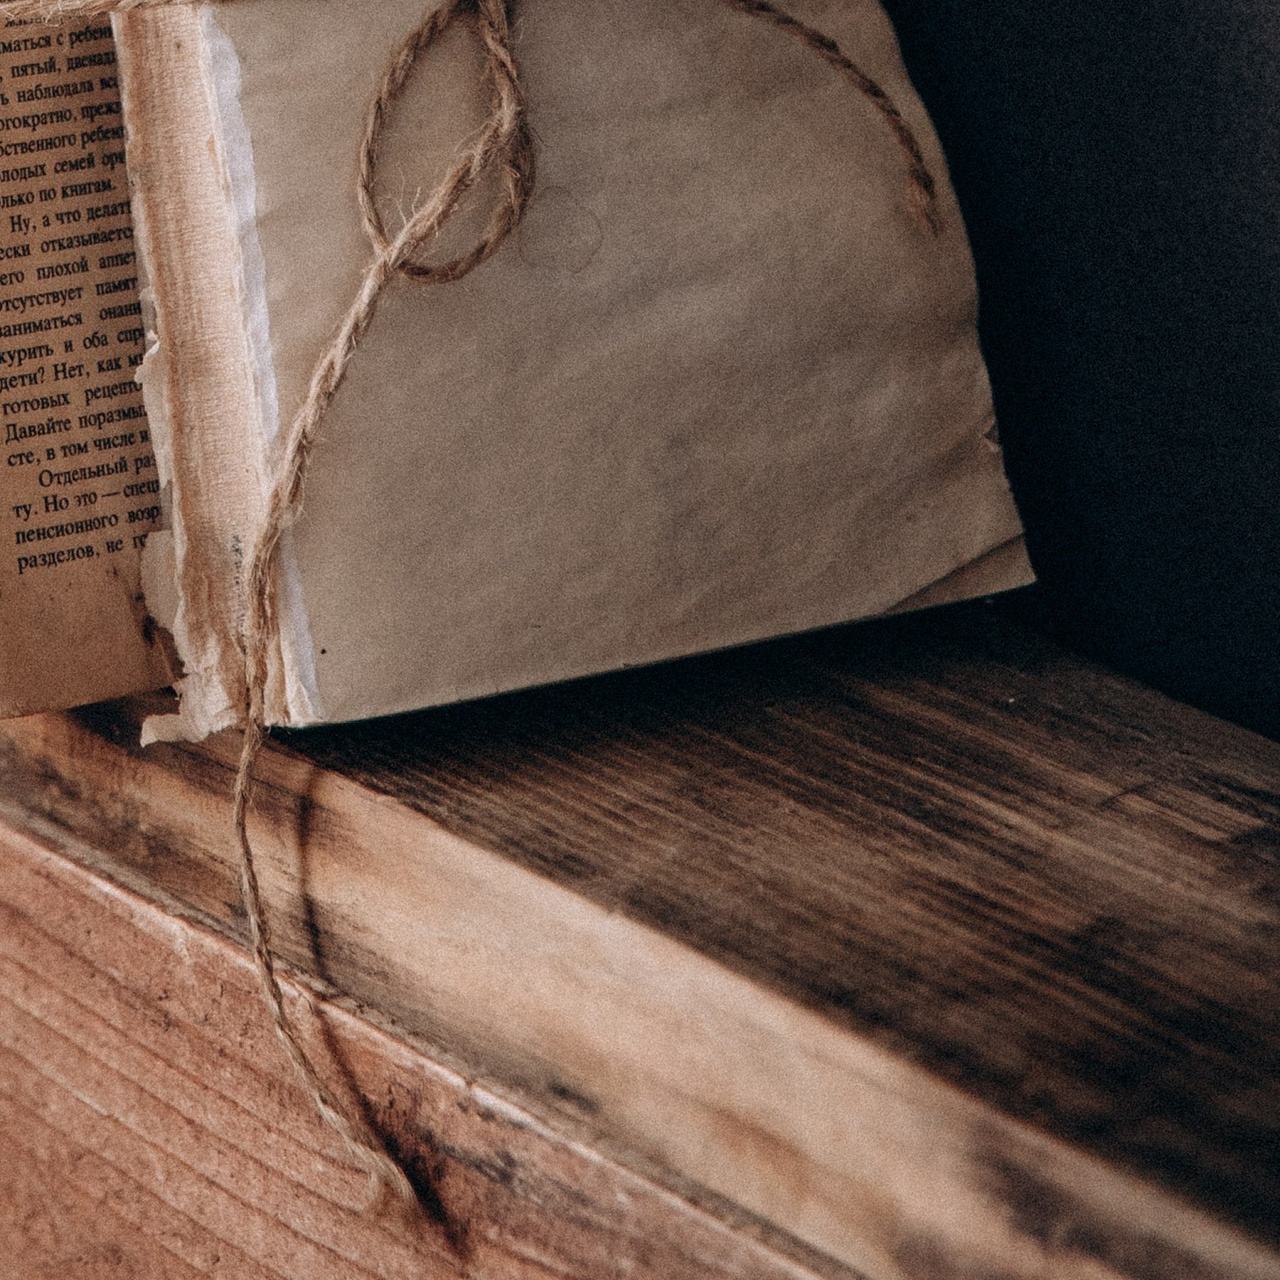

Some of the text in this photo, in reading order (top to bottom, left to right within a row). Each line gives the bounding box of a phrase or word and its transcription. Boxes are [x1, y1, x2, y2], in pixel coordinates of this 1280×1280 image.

[55, 33, 65, 47] с
[10, 55, 62, 79] пятый,
[16, 78, 94, 104] наблюдала
[53, 152, 96, 174] семей
[38, 187, 57, 203] по
[60, 178, 117, 200] книгам.
[9, 213, 37, 236] Ну,
[42, 214, 51, 228] а
[55, 209, 82, 226] что
[36, 255, 90, 281] плохой
[63, 340, 74, 354] и
[82, 330, 109, 350] оба
[52, 361, 91, 383] Нет,
[96, 356, 122, 374] как
[2, 391, 71, 417] готовых
[4, 417, 72, 445] Давайте
[7, 428, 151, 467] сте, в том числе и
[38, 455, 129, 488] Отдельный
[12, 502, 38, 522] ту.
[42, 494, 70, 514] Но
[73, 491, 98, 508] это
[14, 504, 162, 546] пенсионного возр
[17, 543, 101, 575] разделов,
[105, 538, 124, 555] не
